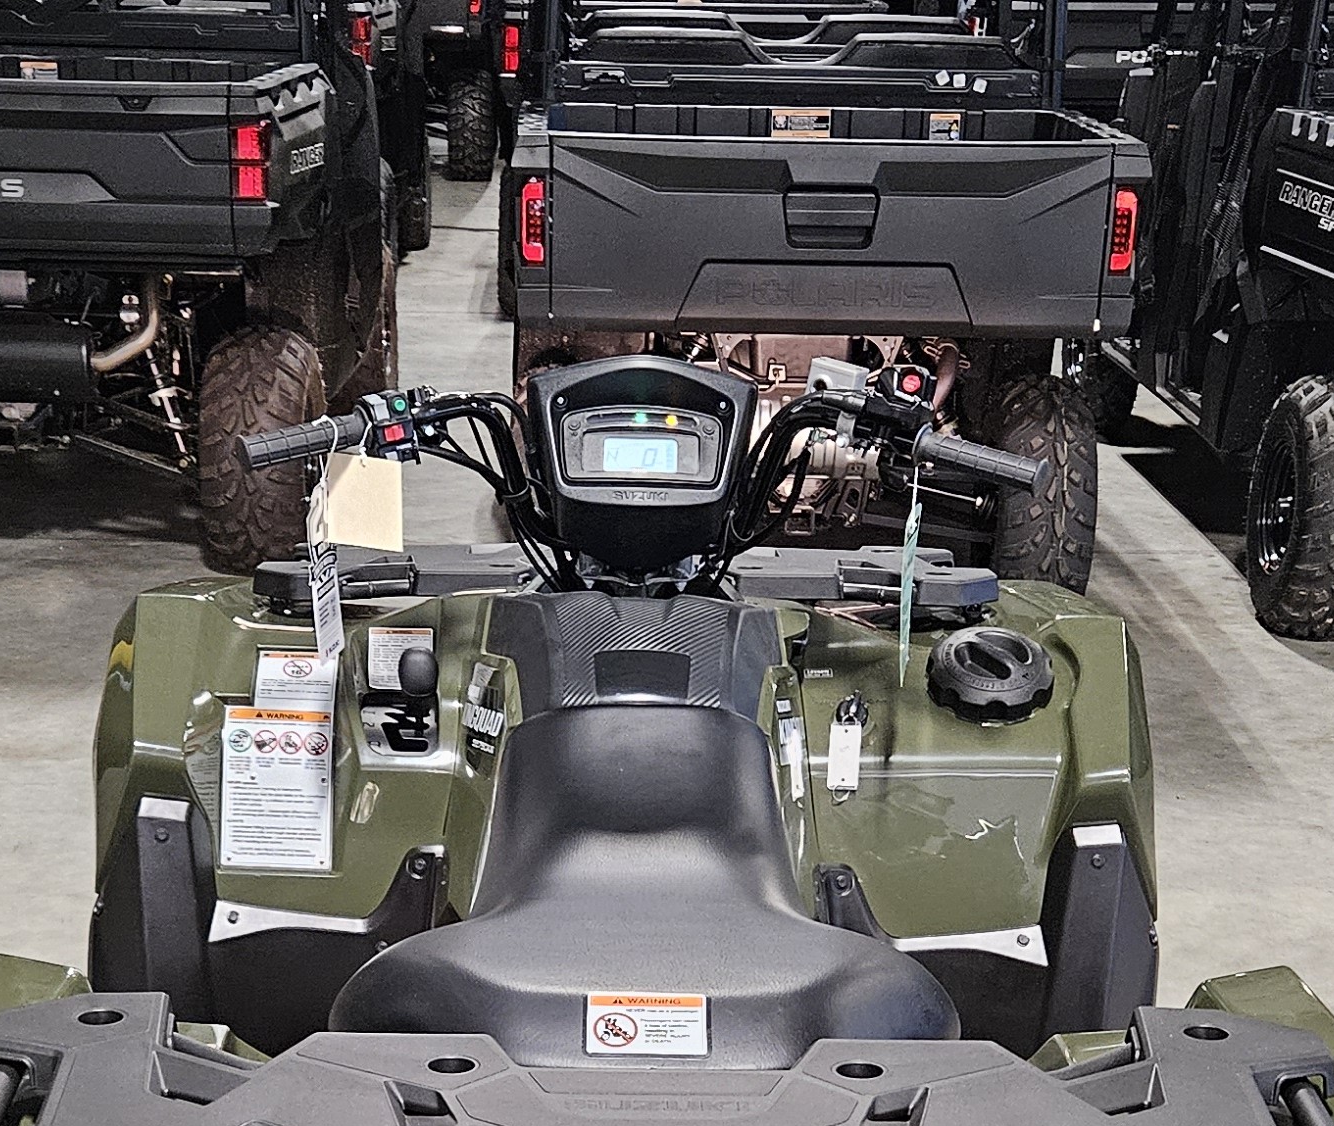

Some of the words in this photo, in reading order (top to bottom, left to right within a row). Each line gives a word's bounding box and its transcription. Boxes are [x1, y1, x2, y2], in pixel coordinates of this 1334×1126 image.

[716, 280, 937, 309] POLARIS
[612, 490, 669, 502] SUZUKI
[267, 712, 304, 720] WARNING
